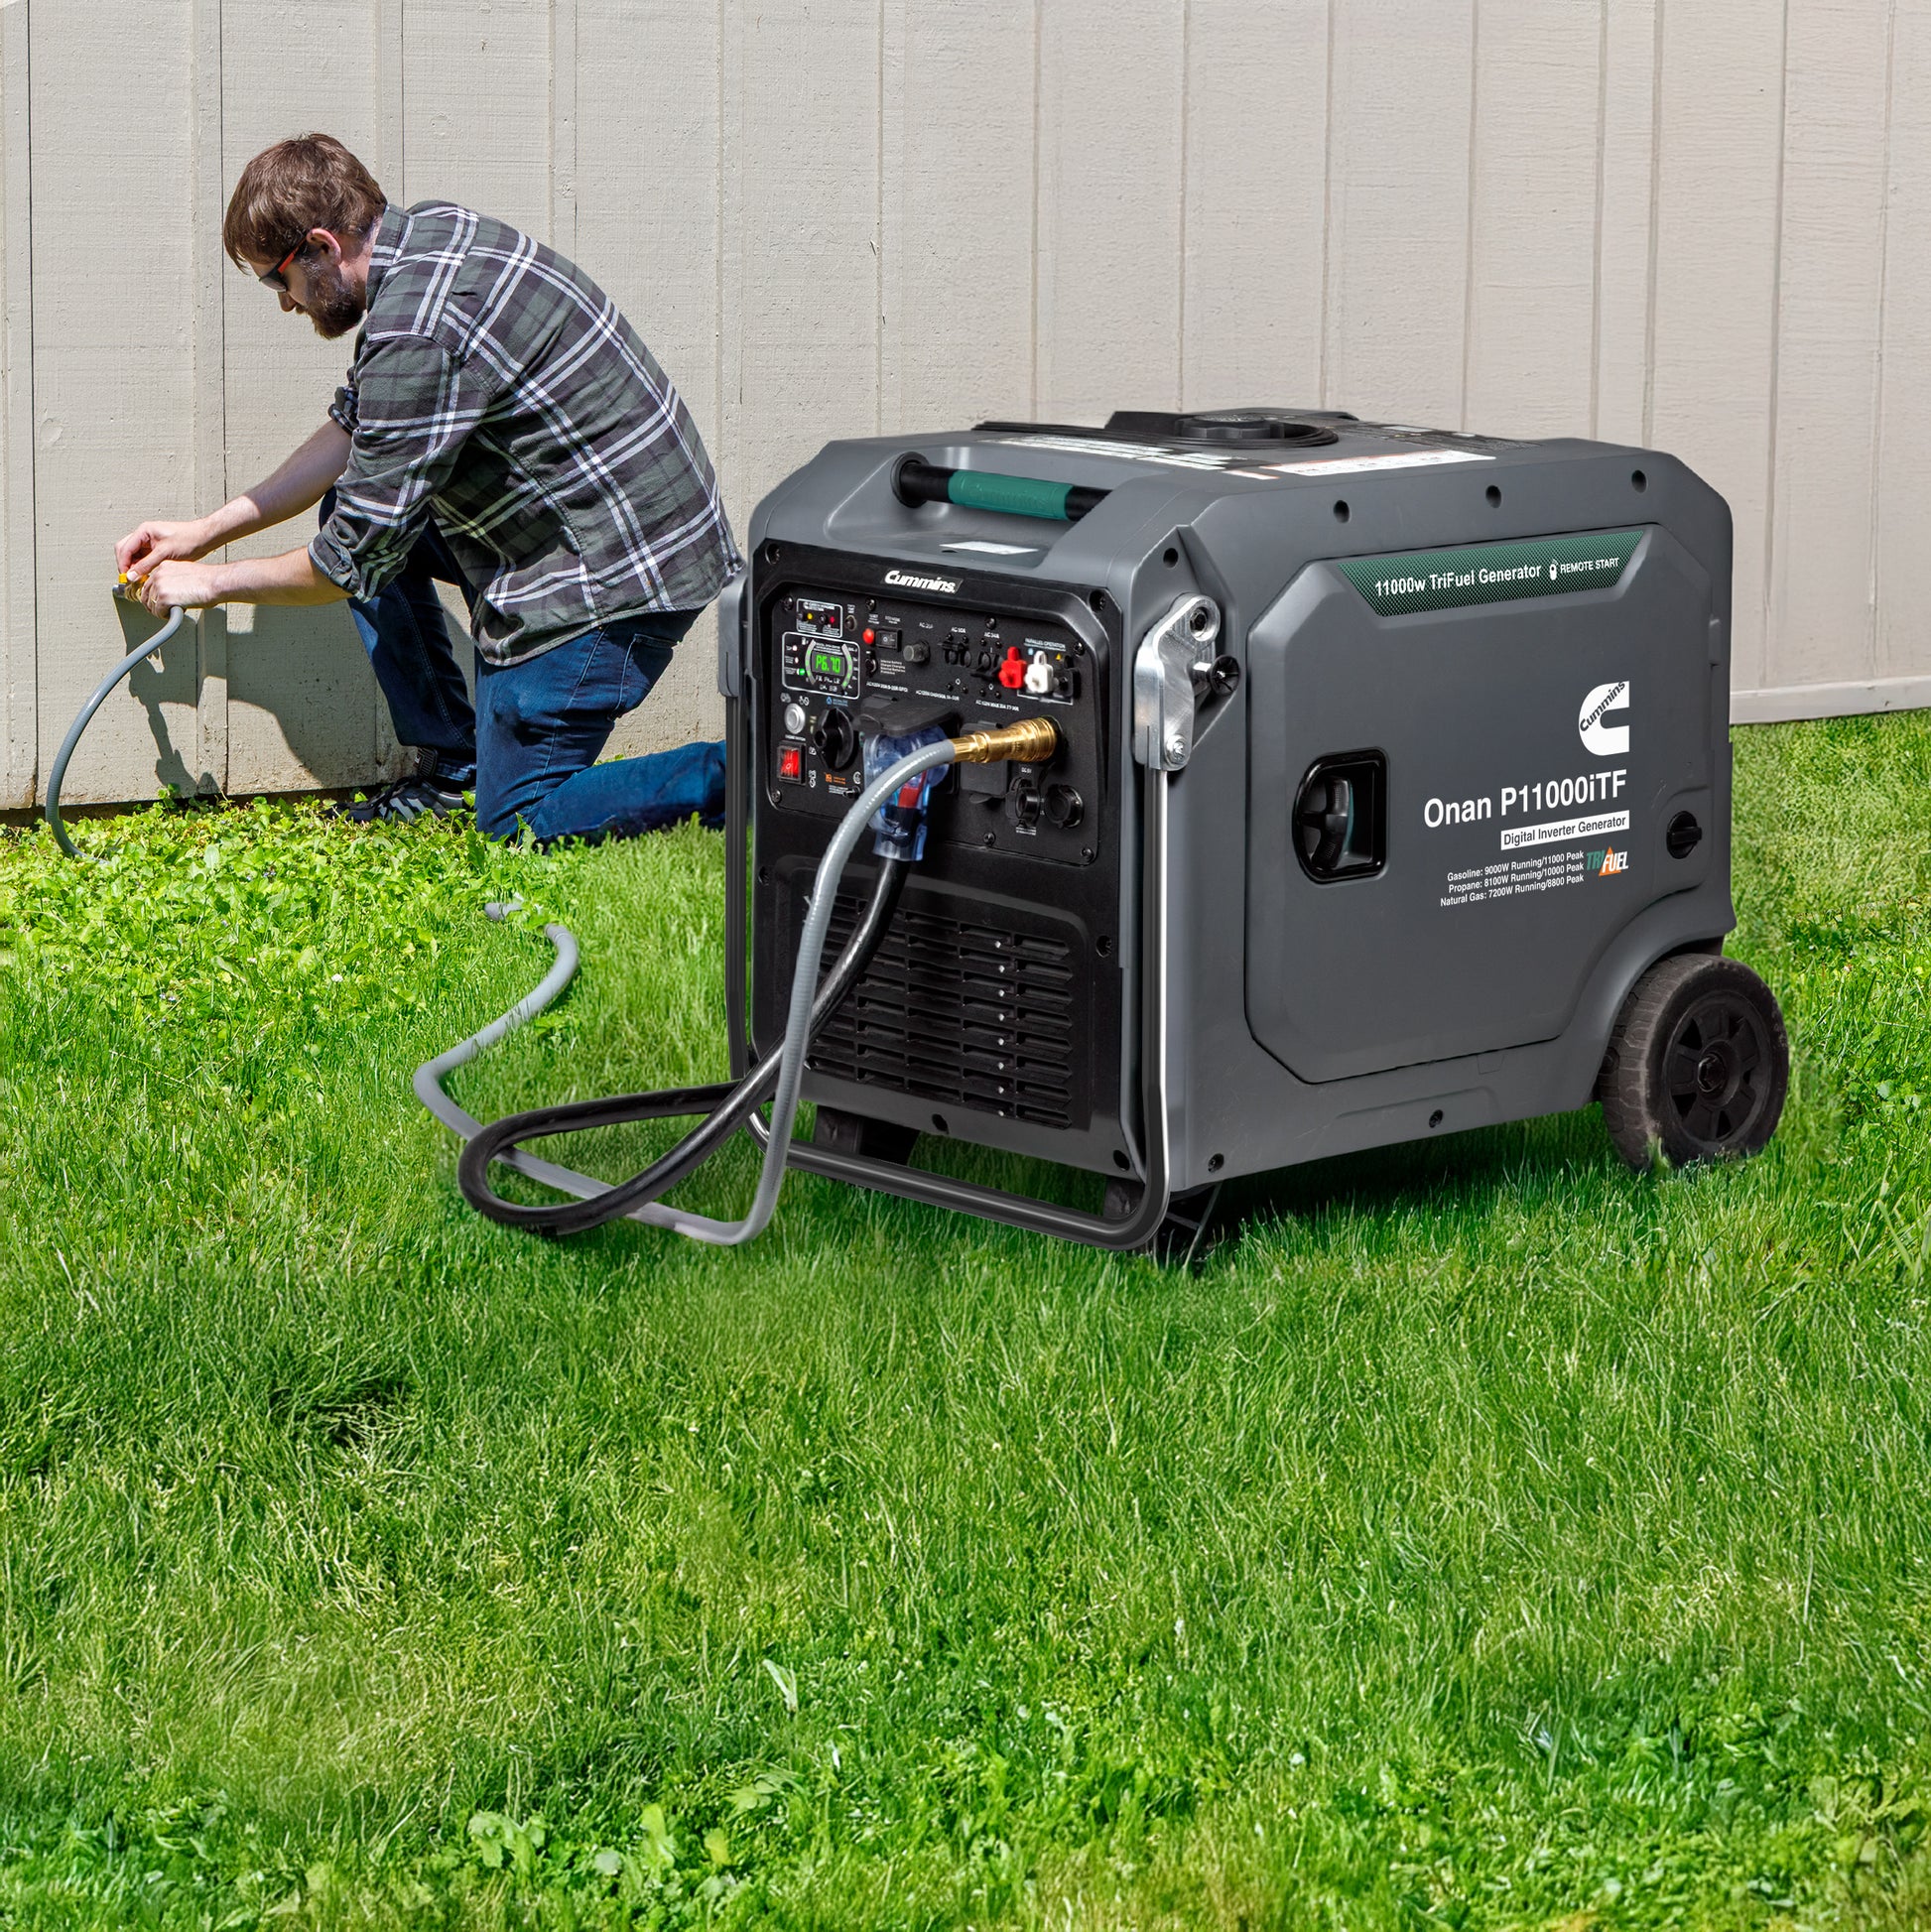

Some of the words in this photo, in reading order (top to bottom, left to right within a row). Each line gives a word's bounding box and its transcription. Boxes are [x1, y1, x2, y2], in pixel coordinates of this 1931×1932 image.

[1374, 578, 1426, 596] 11000w
[1430, 570, 1475, 590] TriFuel
[1479, 565, 1541, 583] Generator
[1560, 561, 1594, 574] REMOTE
[1596, 558, 1619, 570] START
[1580, 681, 1625, 732] Cummins
[1424, 797, 1491, 828] Onan
[1500, 769, 1627, 816] P11000iTF
[1503, 830, 1535, 846] Digital
[1538, 824, 1576, 839] Inverter
[1578, 816, 1626, 833] Generator
[1447, 868, 1483, 881] Gasoline:
[1484, 862, 1510, 875] 9000W
[1510, 853, 1565, 870] Running/11000
[1566, 850, 1585, 861] Peak
[1449, 881, 1482, 894] Propane:
[1483, 874, 1509, 887] 8100W
[1510, 865, 1565, 882] Running/10000
[1566, 862, 1585, 873] Peak
[1440, 894, 1468, 907] Natural
[1469, 891, 1487, 902] Gas:
[1488, 885, 1513, 898] 7200W
[1514, 877, 1565, 894] Running/8800
[1566, 873, 1585, 885] Peak
